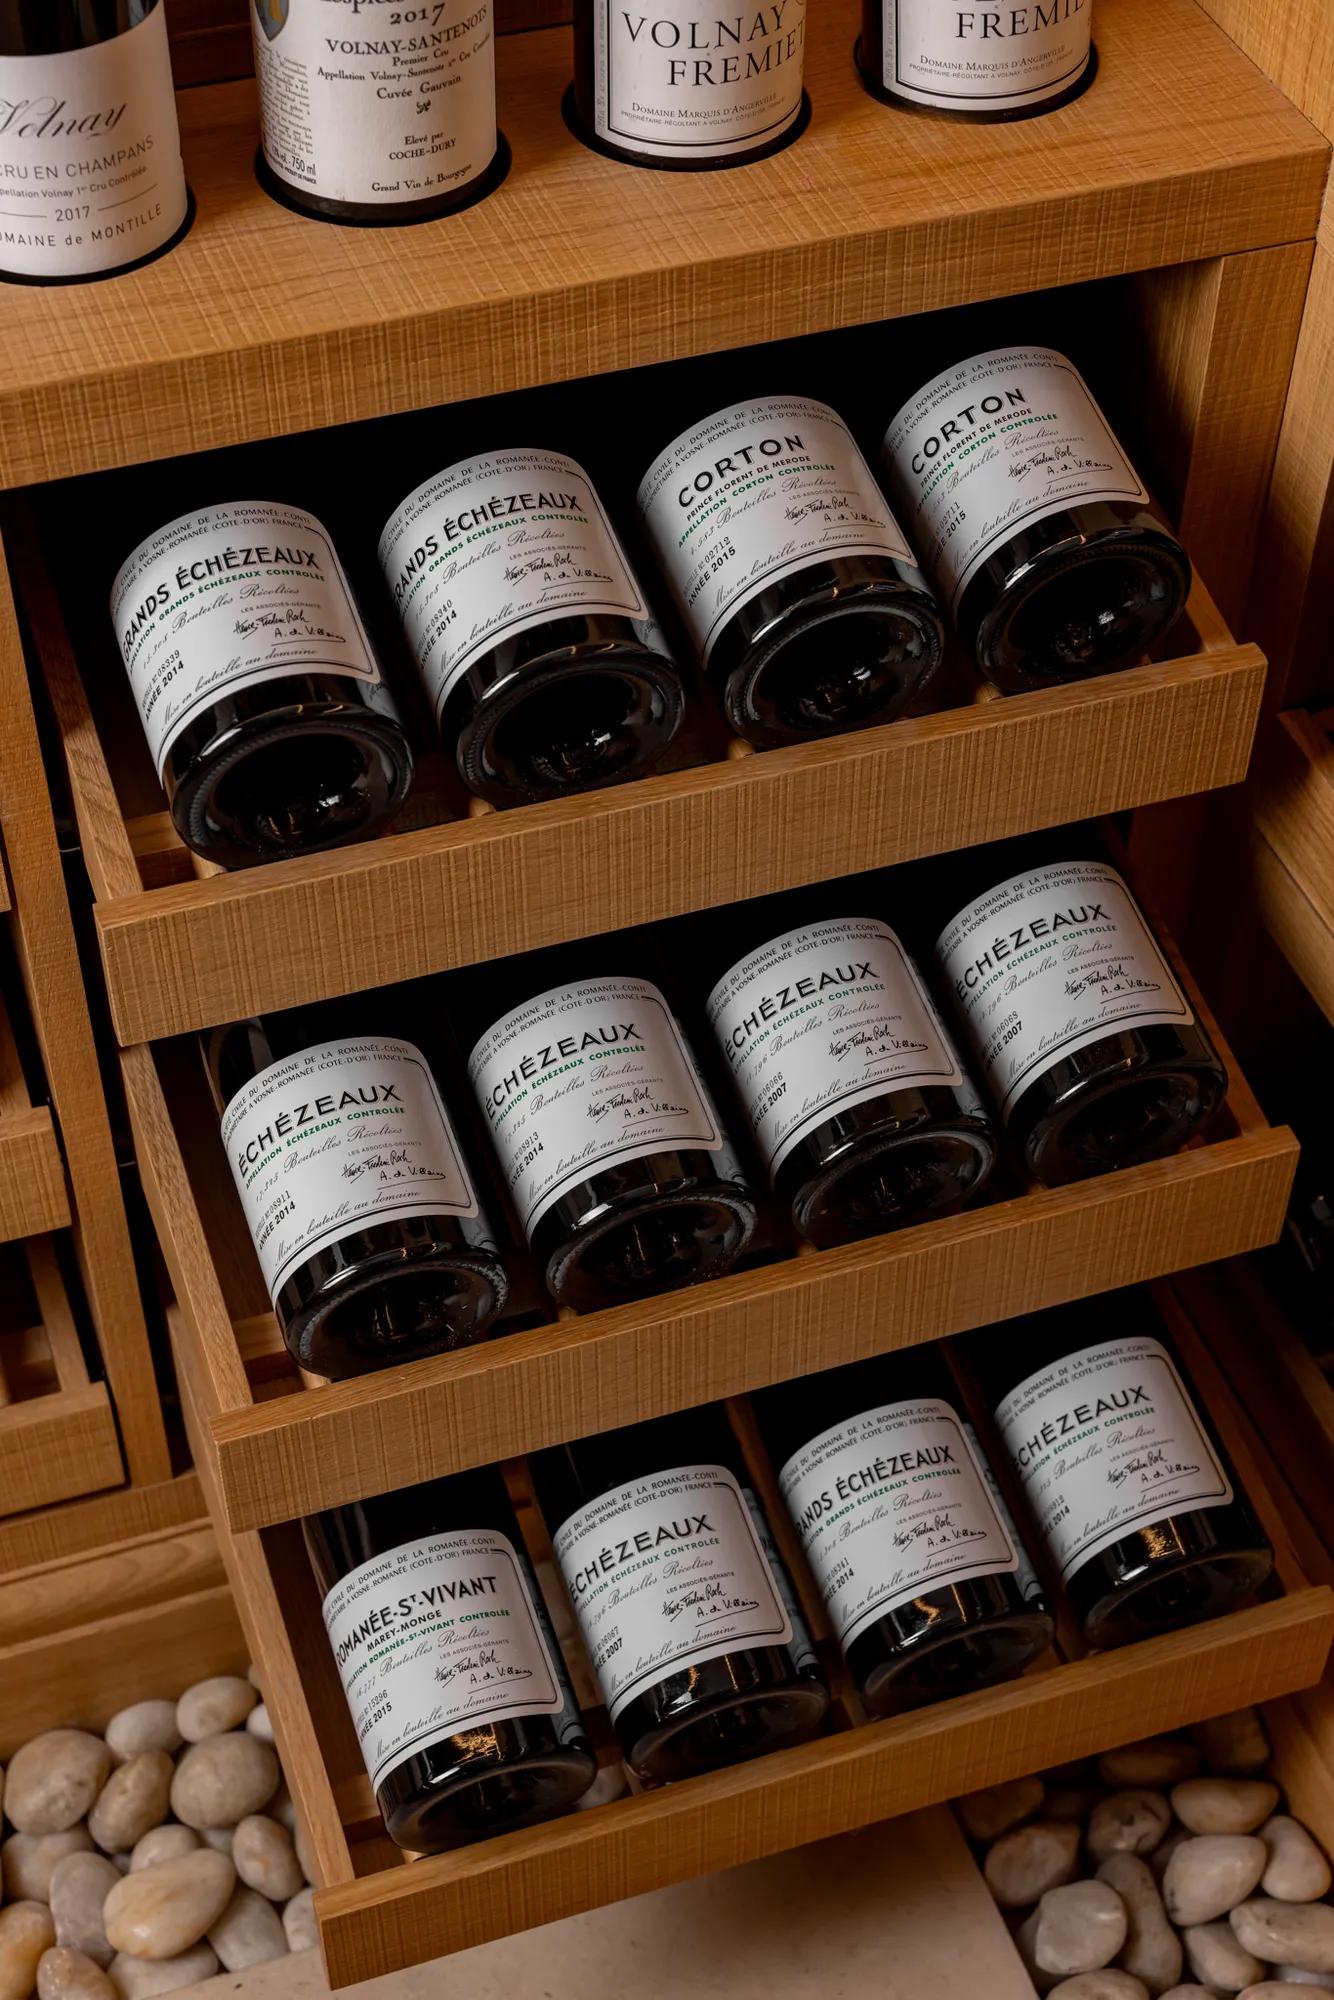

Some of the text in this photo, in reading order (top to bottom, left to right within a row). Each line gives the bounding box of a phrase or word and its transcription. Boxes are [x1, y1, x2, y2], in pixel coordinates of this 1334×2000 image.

[326, 6, 487, 55] VOLNAY-SANTENOTS
[390, 3, 445, 26] 2017
[622, 0, 786, 50] VOLNAY
[317, 67, 365, 81] Appellation
[371, 63, 444, 82] Volnay-Santenots
[392, 48, 449, 68] Premier Cru
[377, 76, 462, 100] Cuvée Gauvain
[0, 96, 126, 140] Volnay
[34, 166, 58, 180] EN
[66, 135, 154, 178] CHAMPANS
[389, 138, 456, 161] COCHE-DURY
[405, 132, 444, 146] Elevé par
[291, 158, 305, 173] 750
[306, 165, 316, 176] ml
[372, 163, 472, 192] Grand Vin de Bourgogne
[42, 190, 73, 198] Volnay
[90, 184, 106, 192] Cru
[56, 206, 90, 221] 2017
[66, 235, 82, 245] de
[91, 204, 161, 242] MONTILLE
[911, 388, 1025, 475] CORTON
[920, 408, 1032, 488] PRINCE FLORENT DE MERODE
[958, 413, 1058, 461] CORTON CONTROLÉE
[418, 462, 491, 503] DOMAINE DE LA
[678, 435, 805, 508] CORTON
[686, 455, 811, 522] PRINCE FLORENT DE MERODE
[443, 493, 585, 541] ÉCHÉZEAUX
[678, 464, 836, 548] APPELLATION CORTON CONTROLÉE
[948, 510, 967, 538] 2015
[152, 512, 229, 549] DOMAINE DE LA
[428, 514, 588, 573] GRANDS ÉCHÉZEAUX CONTROLÉE
[159, 568, 325, 621] GRANDS ÉCHÉZEAUX CONTROLÉE
[688, 571, 711, 608] ANNÉE
[713, 546, 736, 573] 2015
[122, 546, 320, 662] GRANDS ÉCHÉZEAUX
[437, 610, 457, 636] 2014
[163, 660, 185, 687] 2014
[265, 648, 318, 661] domaine
[974, 876, 1040, 917] DOMAINE DE LA
[729, 972, 741, 985] DU
[742, 947, 777, 973] DOMAINE
[780, 940, 793, 950] DE
[797, 934, 809, 943] LA
[955, 904, 1112, 1002] ÉCHÉZEAUX
[1006, 925, 1118, 971] ÉCHÉZEAUX CONTROLÉE
[504, 993, 573, 1032] DOMAINE DE LA
[725, 962, 881, 1063] ÉCHÉZEAUX
[773, 998, 824, 1031] ÉCHÉZEAUX
[828, 983, 886, 1001] CONTROLÉE
[1002, 1020, 1024, 1046] 2007
[248, 1084, 259, 1098] DU
[261, 1063, 300, 1087] DOMAINE
[304, 1057, 317, 1066] DE
[321, 1051, 333, 1060] LA
[485, 1023, 642, 1121] ÉCHÉZEAUX
[531, 1044, 646, 1090] ÉCHÉZEAUX CONTROLÉE
[862, 1064, 907, 1082] domaine
[768, 1082, 787, 1108] 2007
[238, 1084, 404, 1179] ÉCHÉZEAUX
[246, 1107, 405, 1190] APPELLATION ÉCHÉZEAUX CONTROLÉE
[525, 1142, 544, 1166] 2014
[274, 1201, 296, 1225] 2014
[353, 1199, 369, 1209] au
[372, 1190, 422, 1205] domaine
[1024, 1375, 1055, 1397] DOMAINE
[811, 1434, 843, 1456] DOMAINE
[1053, 1406, 1156, 1455] ÉCHÉZEAUX CONTROLÉE
[835, 1445, 955, 1501] ÉCHÉZEAUX
[584, 1486, 648, 1521] DOMAINE DE LA
[825, 1468, 961, 1526] GRANDS ÉCHÉZEAUX CONTROLÉE
[1053, 1506, 1071, 1527] 2014
[357, 1561, 393, 1583] DOMAINE
[397, 1555, 408, 1564] DE
[413, 1549, 424, 1557] LA
[570, 1514, 716, 1604] ÉCHÉZEAUX
[611, 1537, 720, 1584] ÉCHÉZEAUX CONTROLÉE
[835, 1568, 855, 1592] 2014
[367, 1609, 442, 1652] MAREY-MONGE
[459, 1608, 511, 1623] CONTROLÉE
[605, 1637, 623, 1661] 2007
[373, 1702, 393, 1725] 2015
